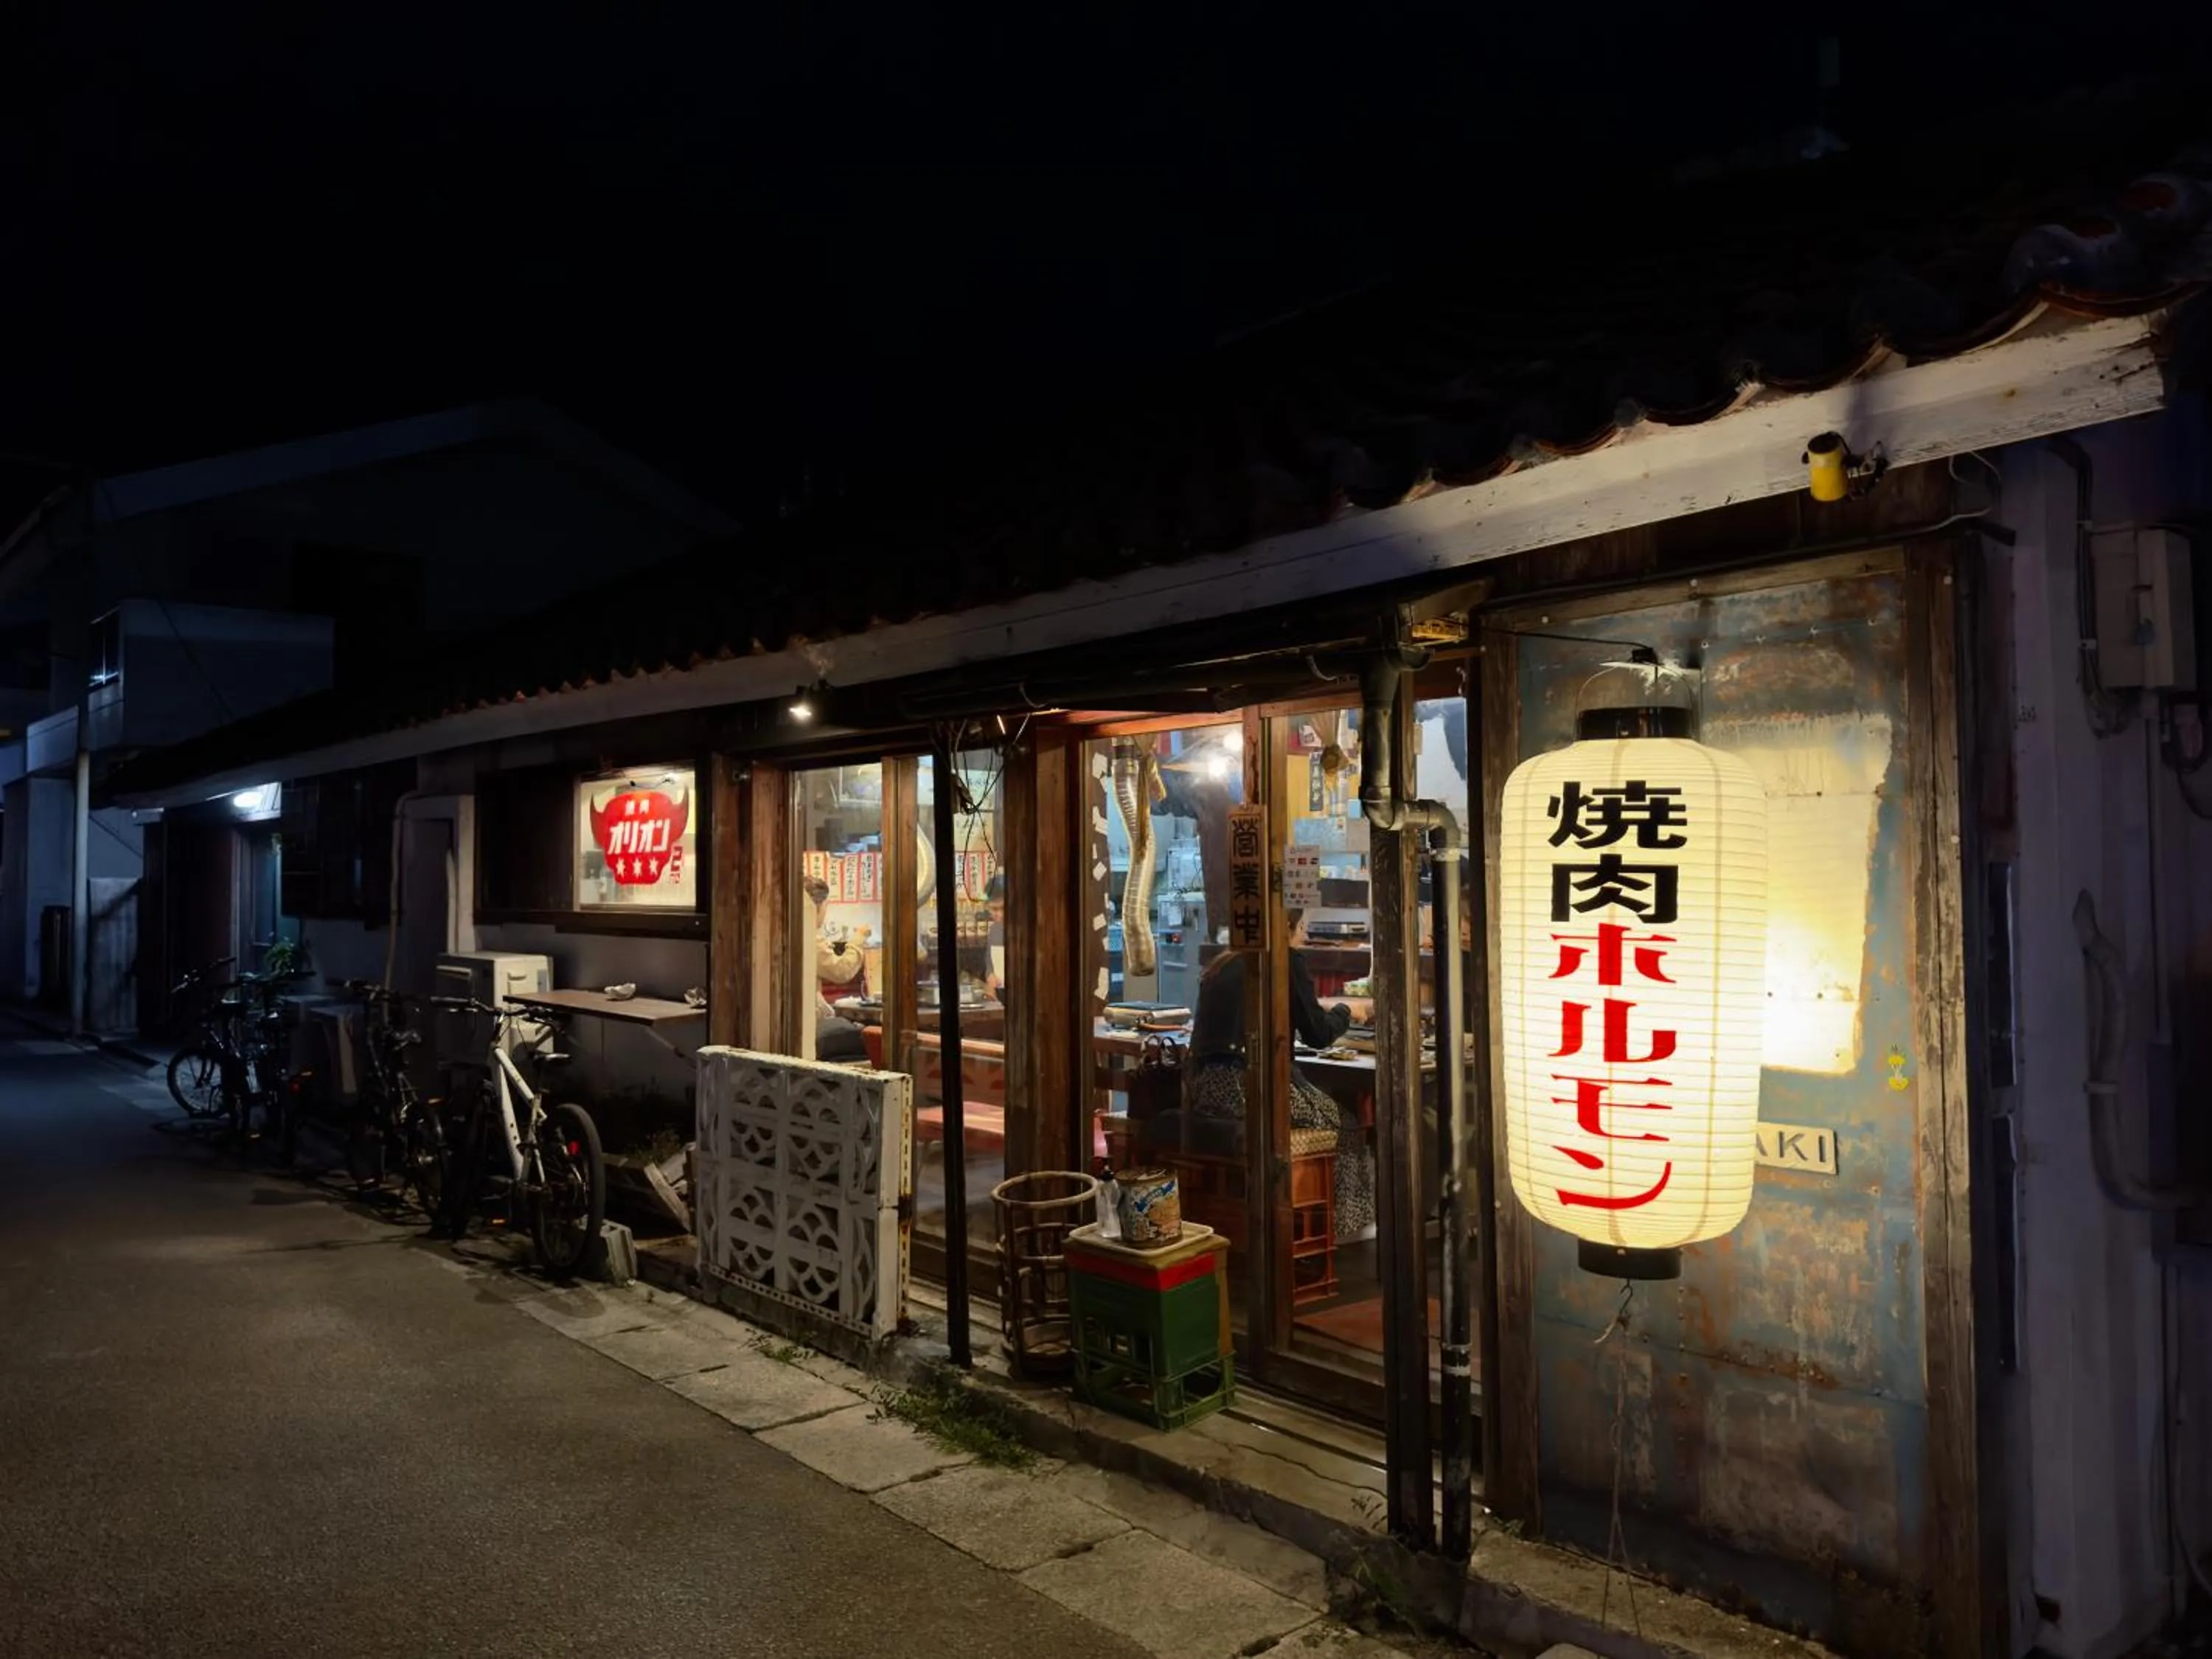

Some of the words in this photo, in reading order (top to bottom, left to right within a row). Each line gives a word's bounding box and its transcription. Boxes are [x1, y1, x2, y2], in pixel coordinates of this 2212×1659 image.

[608, 818, 671, 855] オリオン
[1547, 779, 1687, 1209] 焼肉ホルモン
